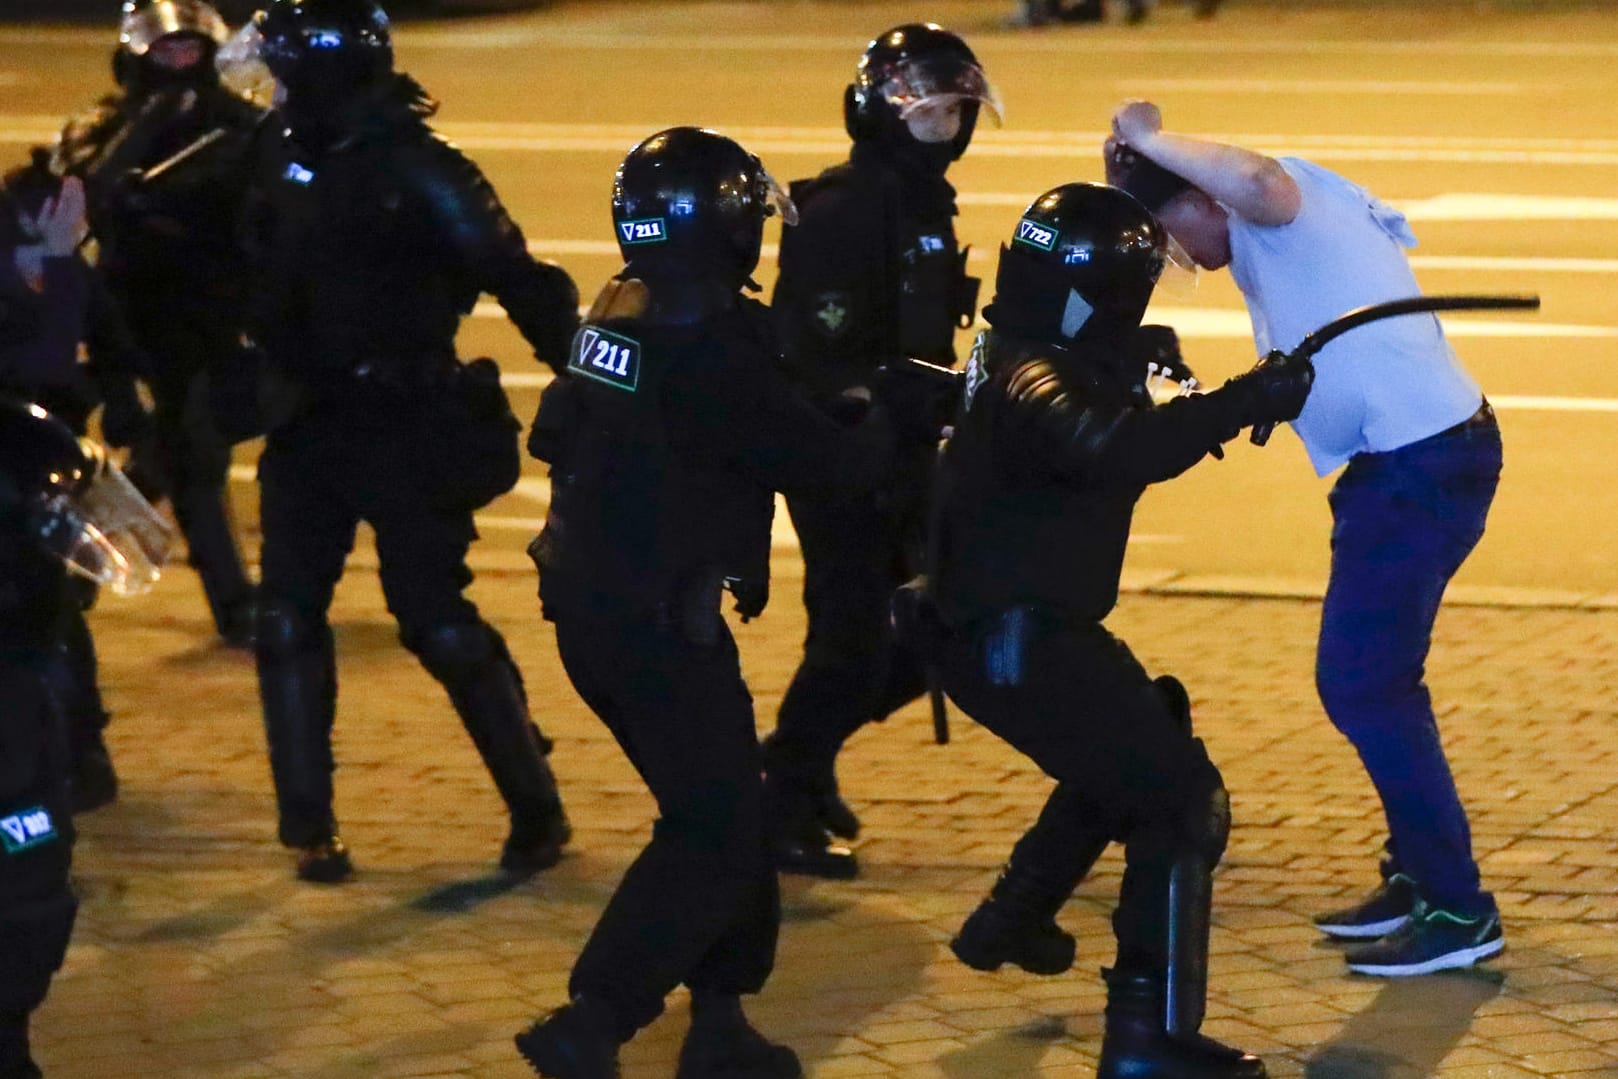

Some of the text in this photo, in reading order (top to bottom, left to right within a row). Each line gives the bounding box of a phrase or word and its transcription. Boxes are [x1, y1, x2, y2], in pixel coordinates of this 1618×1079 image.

[635, 223, 661, 238] 211
[1029, 227, 1052, 245] 722
[592, 340, 630, 376] 211
